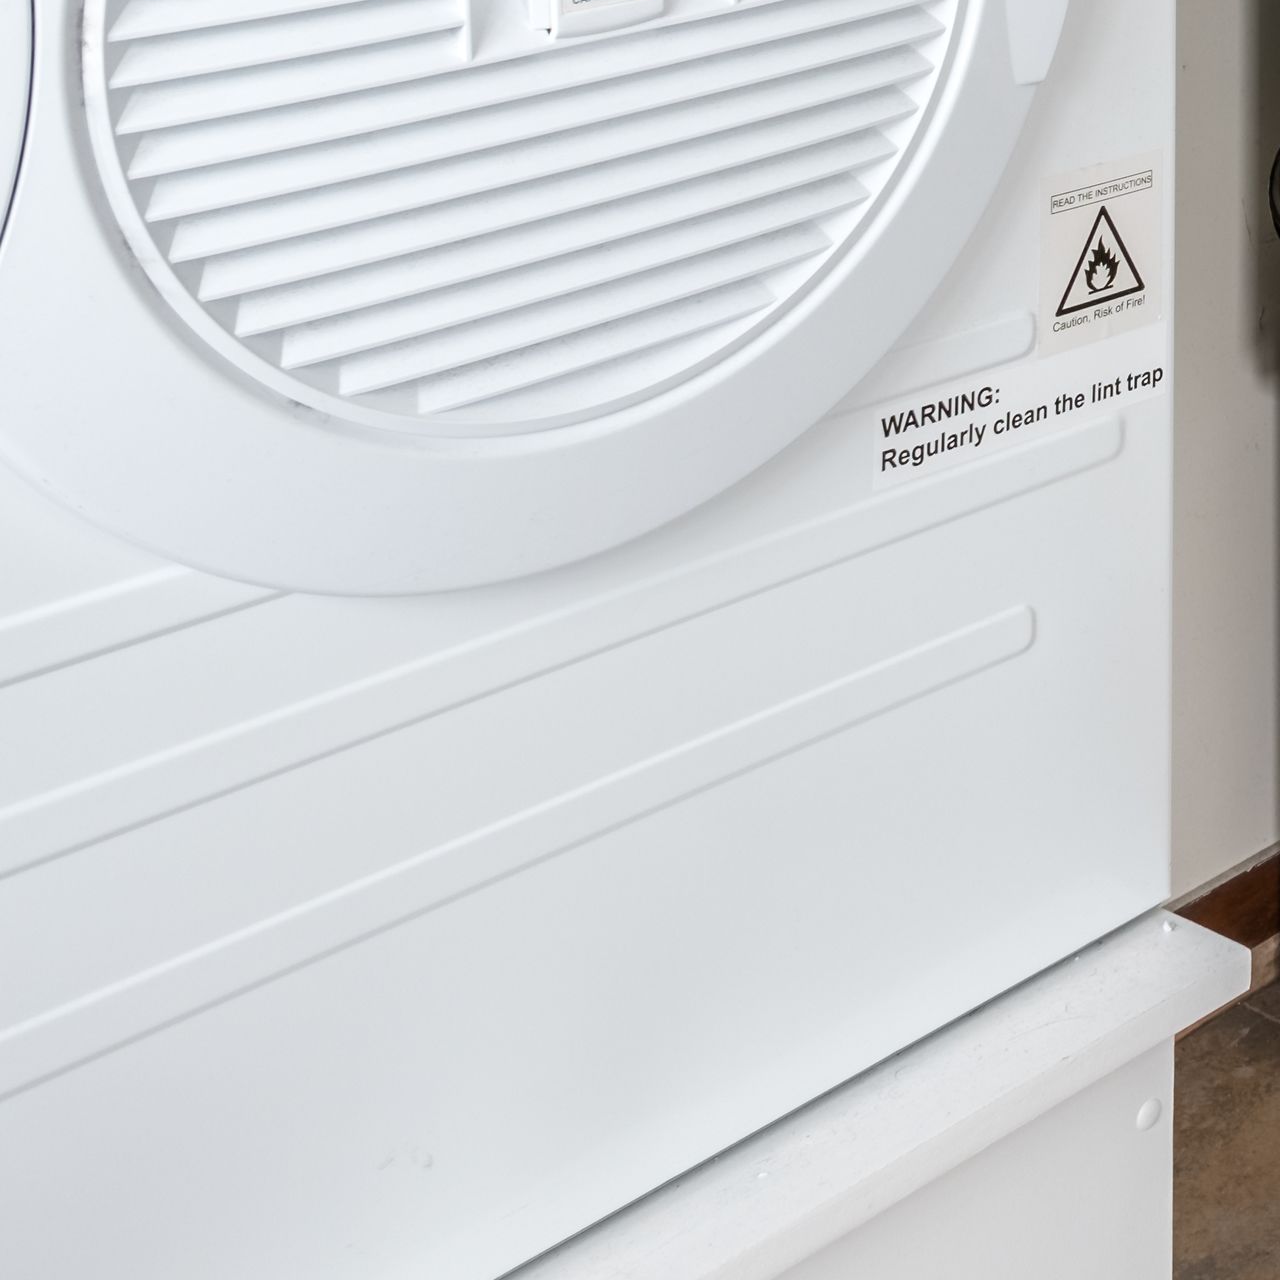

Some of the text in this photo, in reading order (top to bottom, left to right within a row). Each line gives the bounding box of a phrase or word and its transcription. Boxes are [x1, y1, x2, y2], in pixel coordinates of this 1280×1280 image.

[1052, 174, 1152, 209] READ THE INSTRUCTIONS
[1052, 294, 1146, 333] Caution, Risk of Fire!
[881, 385, 1001, 439] WARNING:
[881, 367, 1164, 472] Regularly clean the lint trap
